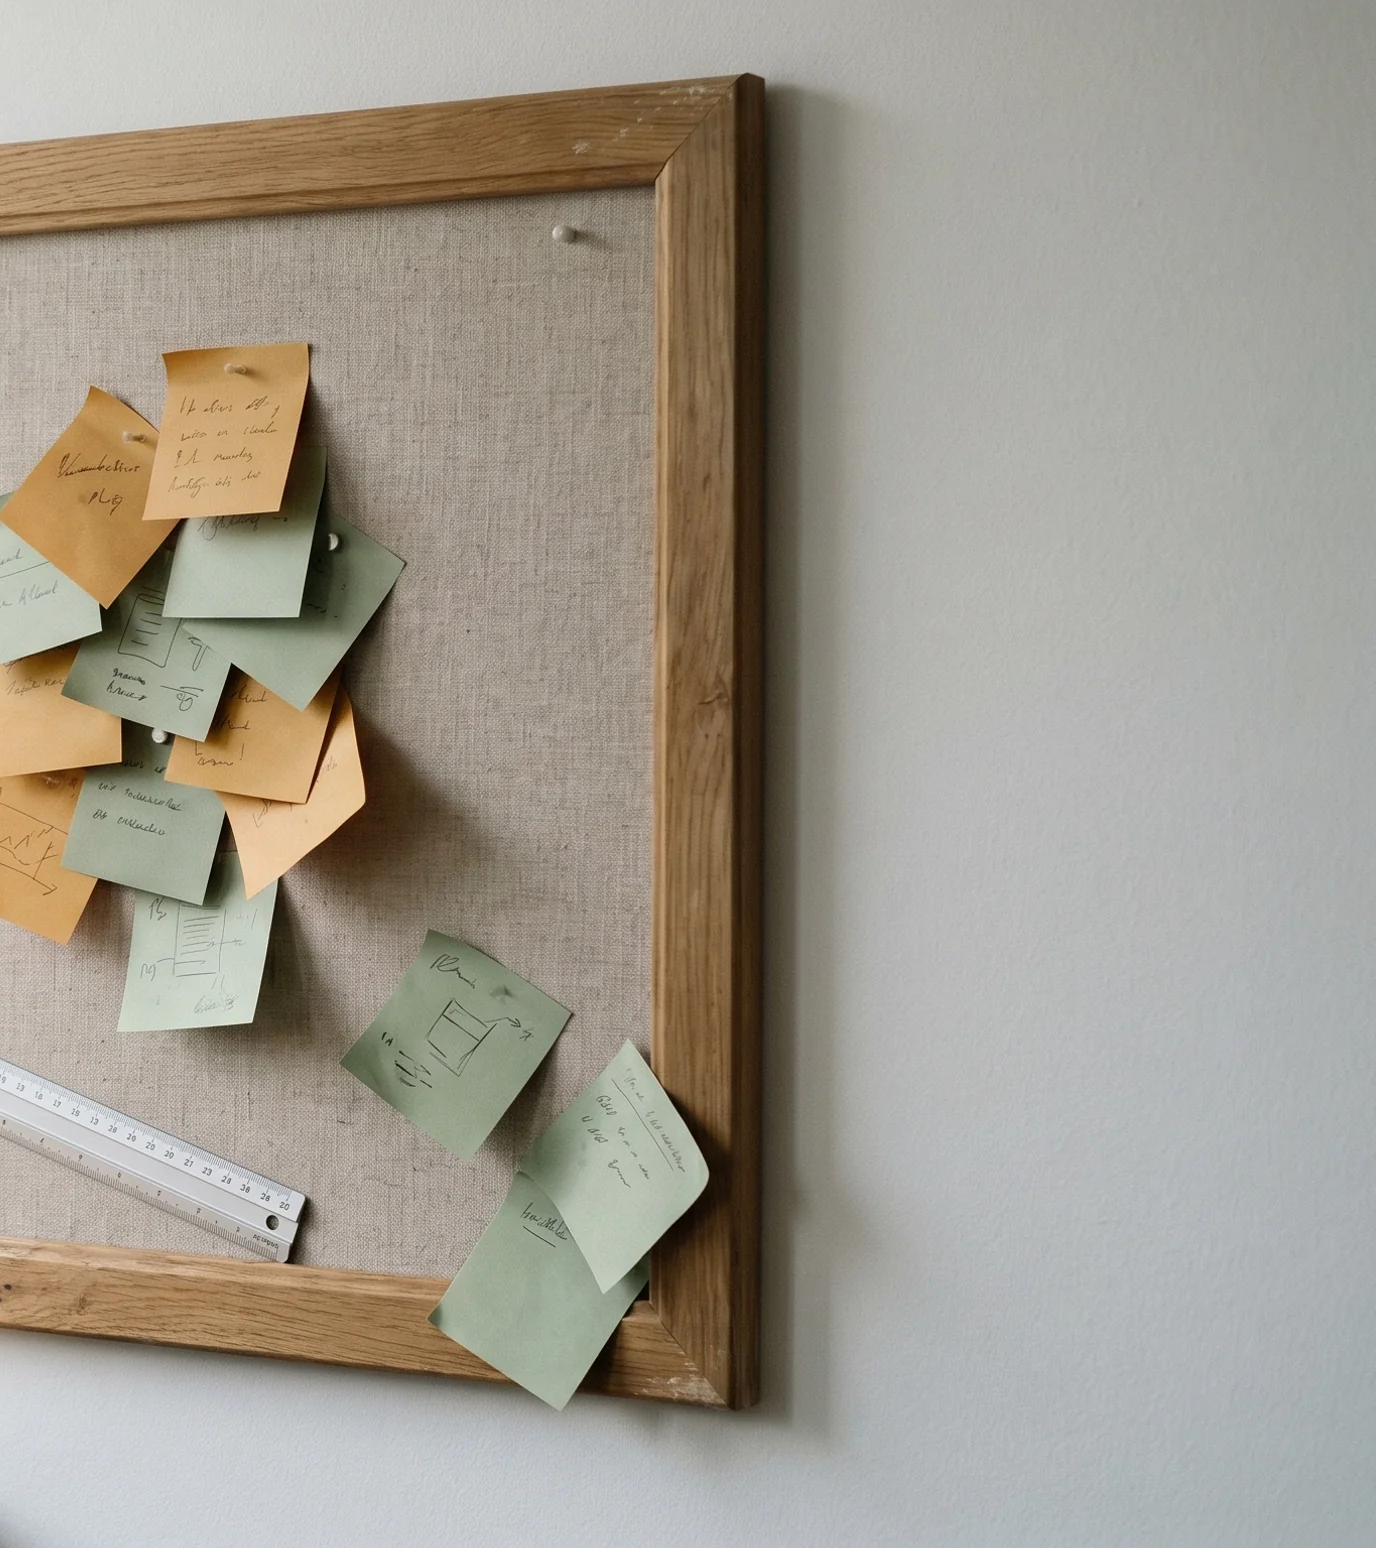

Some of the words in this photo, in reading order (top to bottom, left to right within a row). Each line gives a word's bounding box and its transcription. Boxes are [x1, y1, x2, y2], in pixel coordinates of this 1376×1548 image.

[145, 1141, 156, 1151] 20
[184, 1158, 194, 1168] 21
[202, 1167, 213, 1176] 23
[279, 1201, 290, 1211] 20
